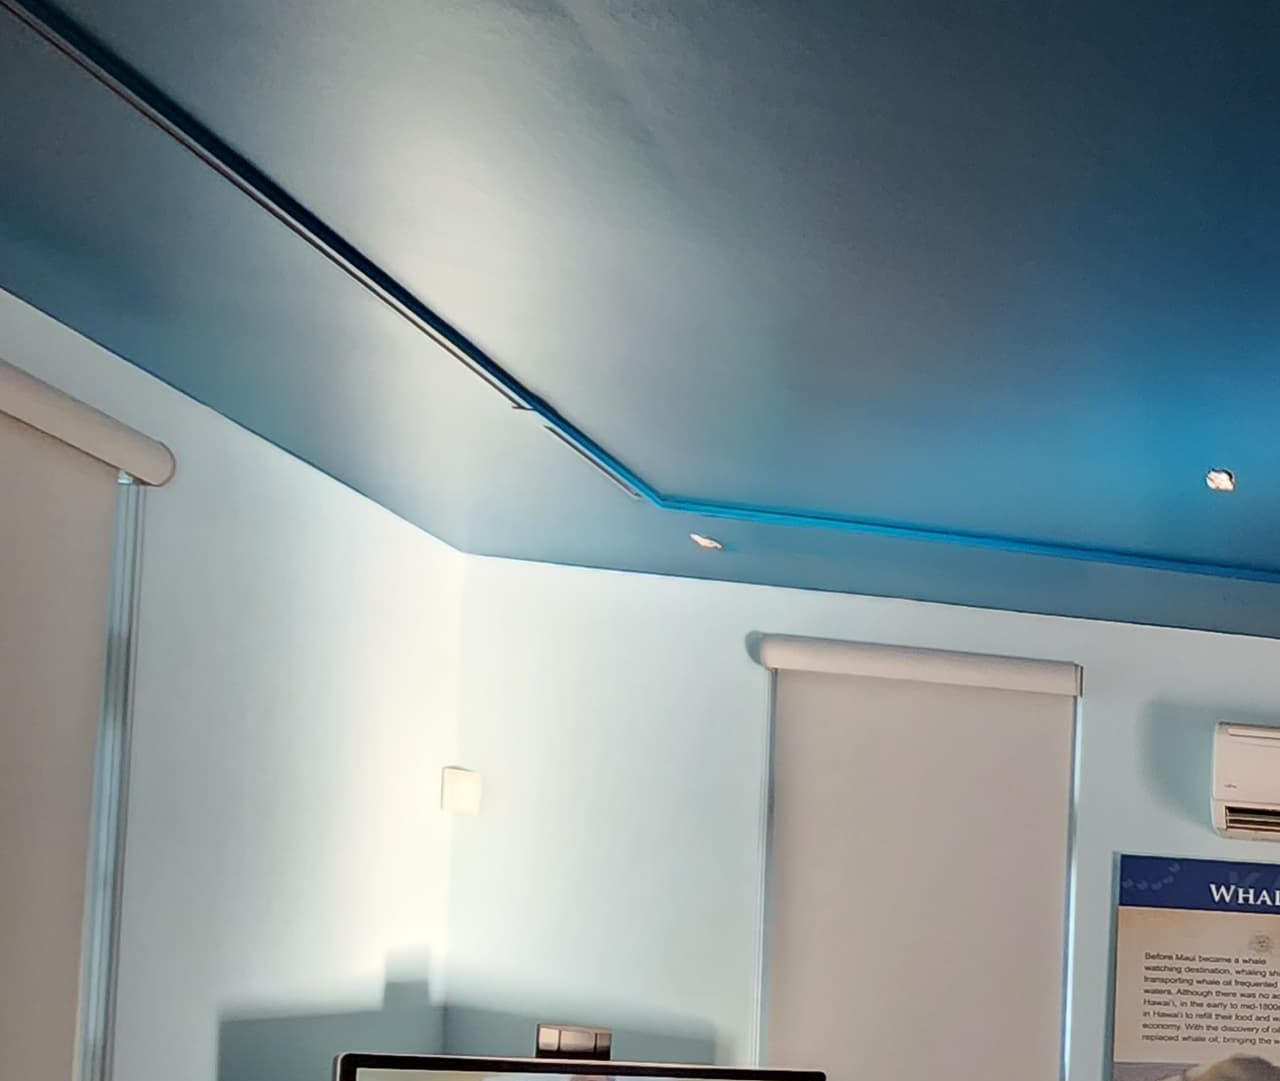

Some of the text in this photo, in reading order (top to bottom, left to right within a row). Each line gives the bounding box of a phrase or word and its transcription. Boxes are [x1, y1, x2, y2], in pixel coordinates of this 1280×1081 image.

[1145, 951, 1173, 960] Before
[1175, 953, 1195, 961] Maui
[1199, 954, 1231, 963] became
[1242, 956, 1266, 965] whale
[1144, 963, 1182, 974] watching
[1184, 965, 1232, 975] destination,
[1236, 967, 1266, 977] whaling
[1144, 975, 1193, 986] transporting
[1196, 977, 1220, 985] whale
[1235, 978, 1277, 989] frequented
[1176, 987, 1212, 998] Although
[1215, 989, 1237, 997] there
[1181, 999, 1187, 1007] in
[1190, 999, 1203, 1007] the
[1206, 1000, 1227, 1010] early
[1230, 1001, 1238, 1009] to
[1185, 1022, 1203, 1031] With
[1206, 1023, 1218, 1031] the
[1221, 1024, 1259, 1035] discovery
[1262, 1025, 1269, 1033] of
[1272, 1025, 1280, 1033] oil
